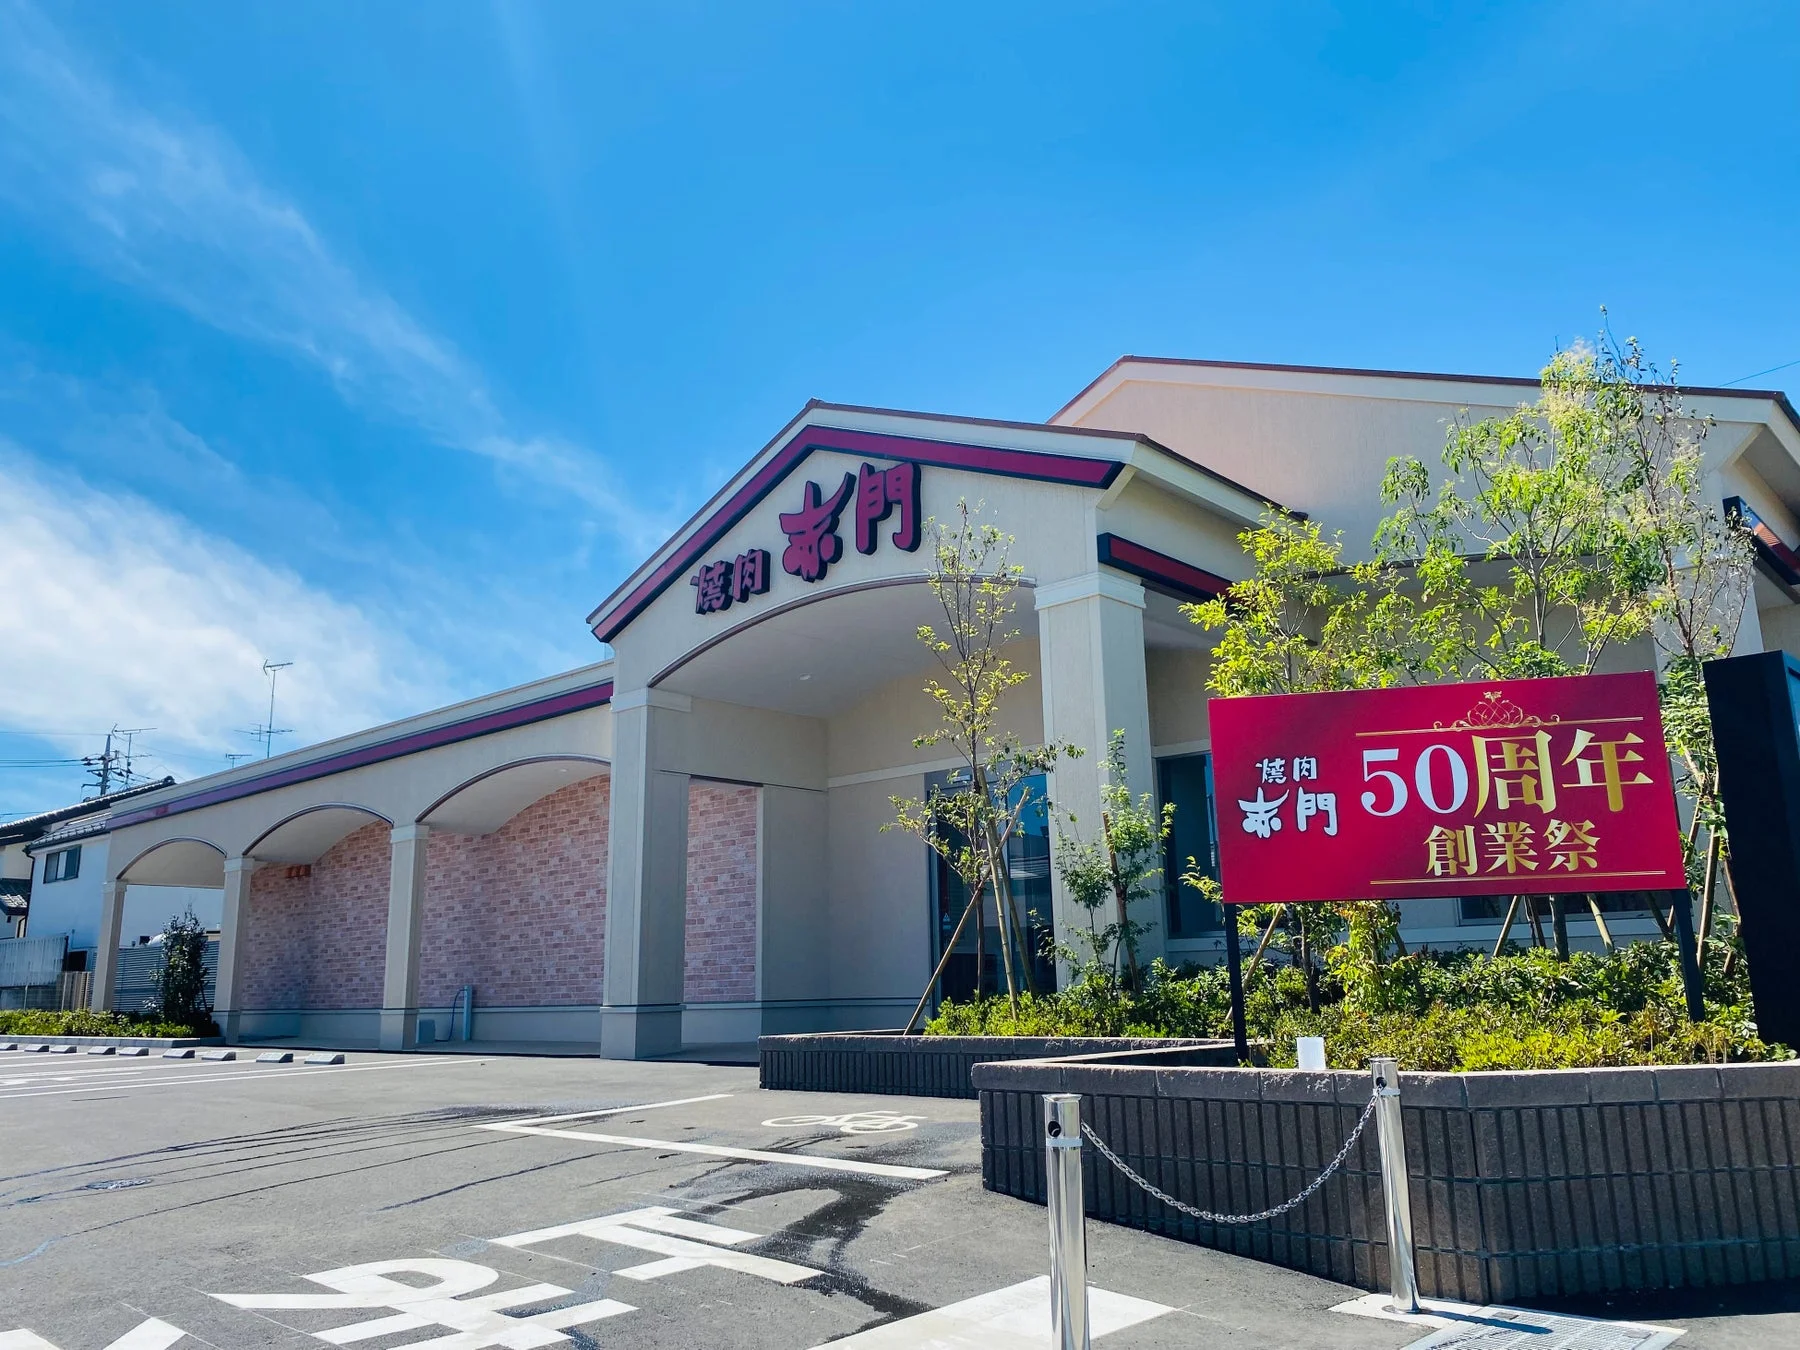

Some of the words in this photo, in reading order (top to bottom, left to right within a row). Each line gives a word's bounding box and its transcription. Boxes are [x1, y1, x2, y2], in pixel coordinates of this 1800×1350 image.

[778, 462, 921, 583] 赤門
[1360, 728, 1654, 818] 50周年
[1237, 786, 1338, 839] 赤門
[1423, 818, 1601, 877] 創業祭
